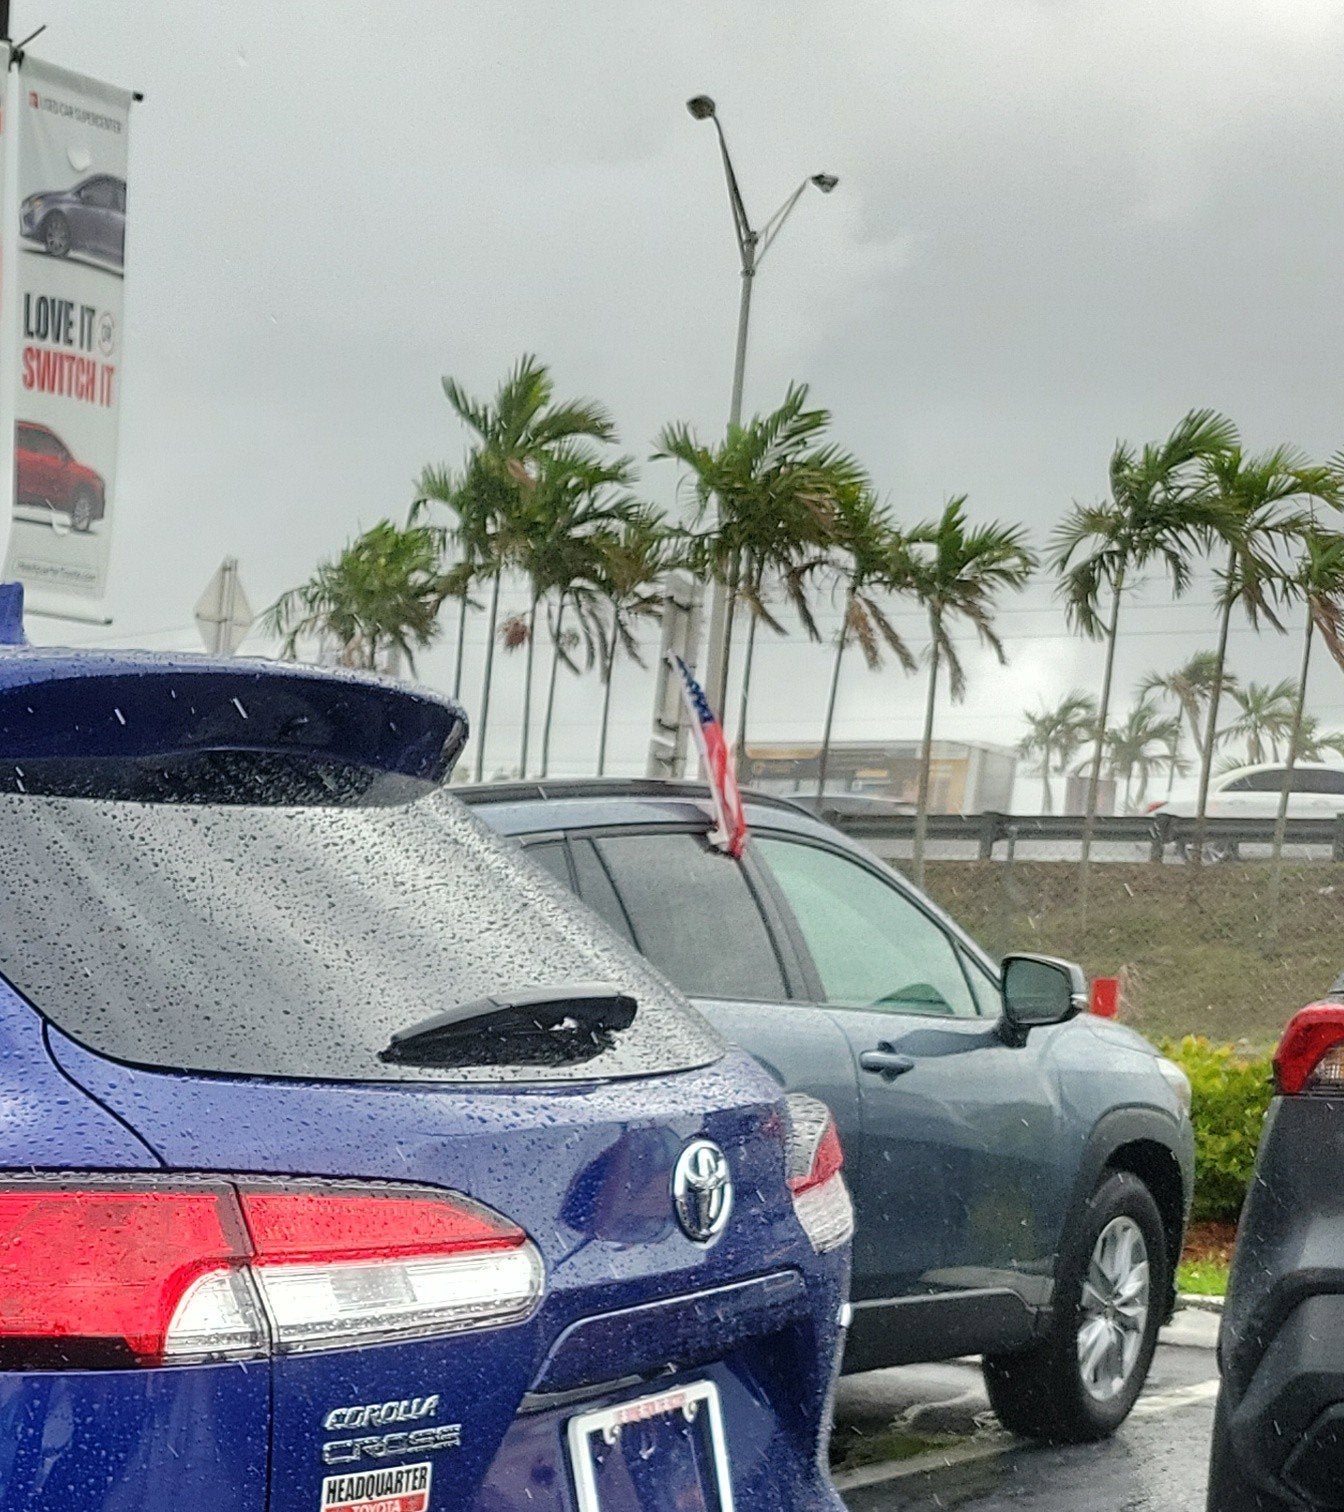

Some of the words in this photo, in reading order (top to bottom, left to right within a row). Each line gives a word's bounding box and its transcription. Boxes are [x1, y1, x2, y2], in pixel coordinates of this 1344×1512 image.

[23, 292, 75, 346] LOVE
[79, 304, 96, 352] IT
[22, 345, 96, 405] SWITCH
[100, 363, 115, 409] IT
[324, 1393, 441, 1431] COROLLA
[322, 1423, 462, 1465] CROSS
[326, 1465, 429, 1505] HEADQUARTER
